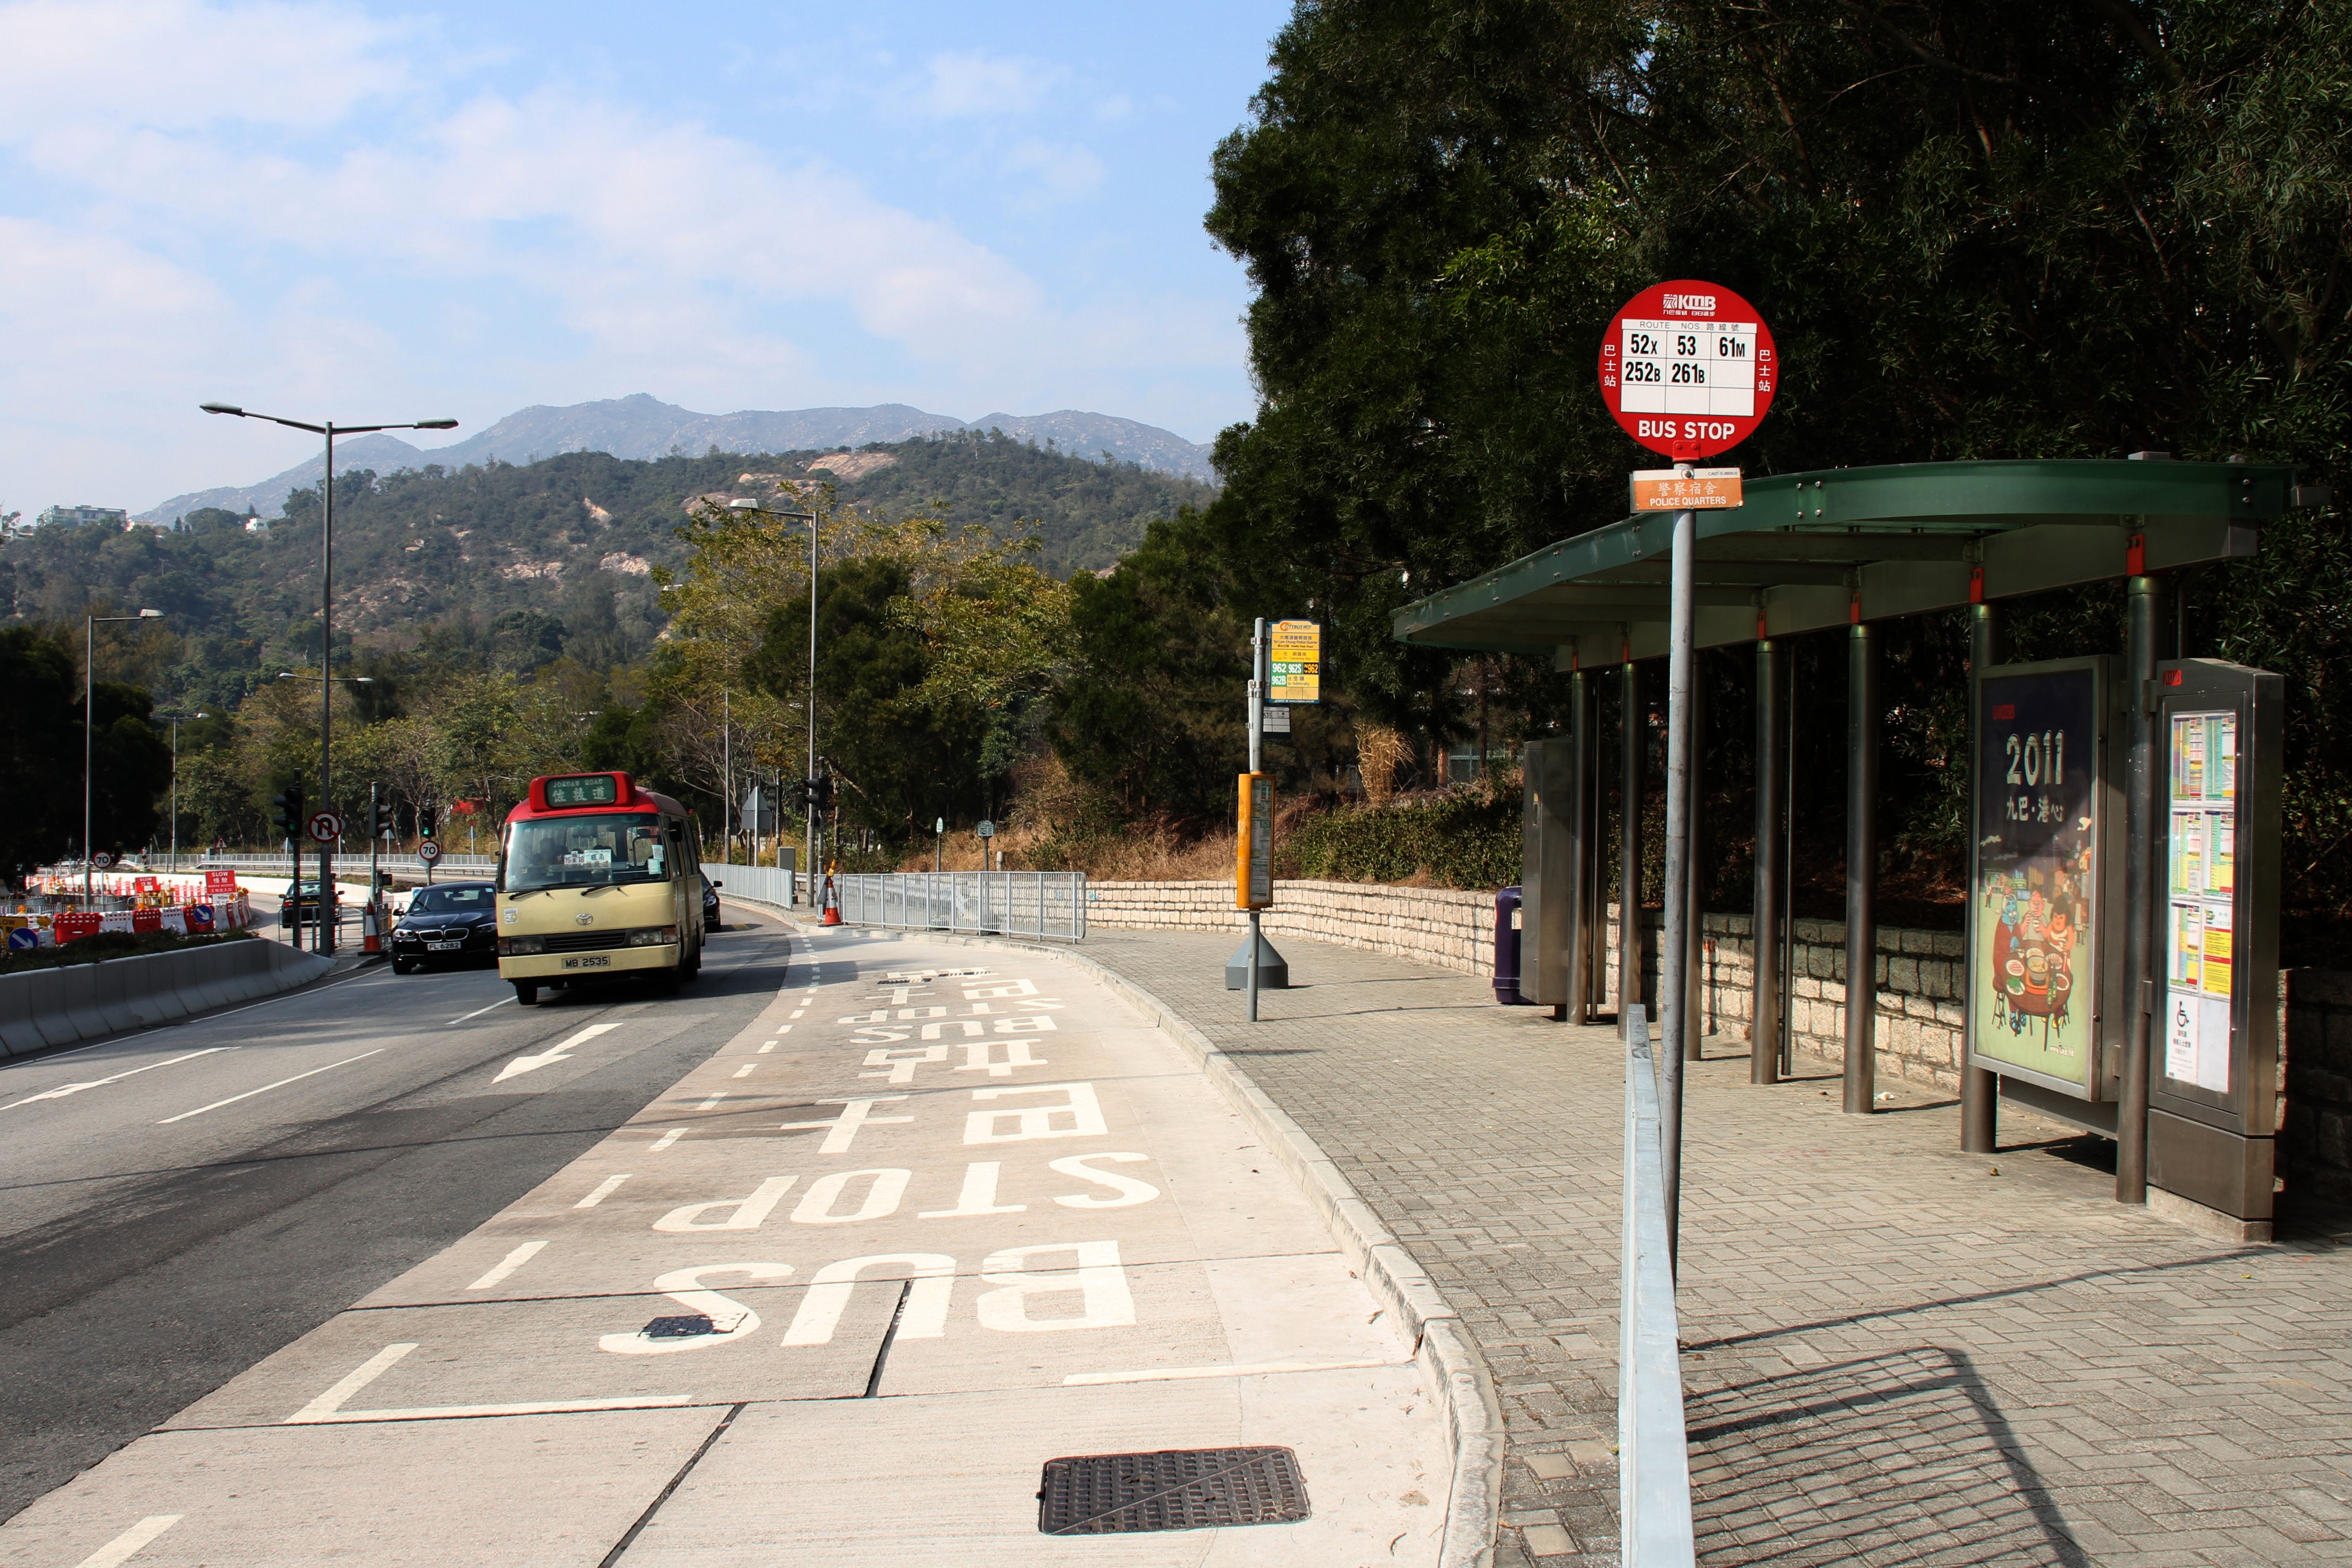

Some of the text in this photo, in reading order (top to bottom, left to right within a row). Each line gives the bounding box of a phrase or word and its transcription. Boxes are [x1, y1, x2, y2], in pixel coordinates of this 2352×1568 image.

[1679, 295, 1716, 310] KMB
[1631, 334, 1745, 357] 52X 53 61M
[1604, 344, 1616, 387] 巴士站
[1625, 361, 1705, 383] 252B 261B
[1759, 350, 1771, 392] 巴士站
[1638, 420, 1735, 440] BUS STOP
[1657, 481, 1718, 497] 警察宿舍
[1650, 496, 1726, 506] POLICE QUARTERS
[1272, 663, 1287, 673] 962
[1288, 663, 1302, 674] 962S
[1272, 675, 1286, 685] 962B
[2006, 729, 2064, 786] 2011
[552, 785, 607, 803] 佐敦道
[553, 780, 580, 788] JORDAN
[96, 856, 110, 864] 70
[422, 847, 436, 855] 70
[565, 956, 608, 967] MB 2535
[837, 998, 1066, 1024] STOP
[849, 1015, 1058, 1043] BUS
[781, 1082, 1108, 1154] 巴士
[652, 1152, 1160, 1232] STOP
[598, 1240, 1136, 1354] BUS
